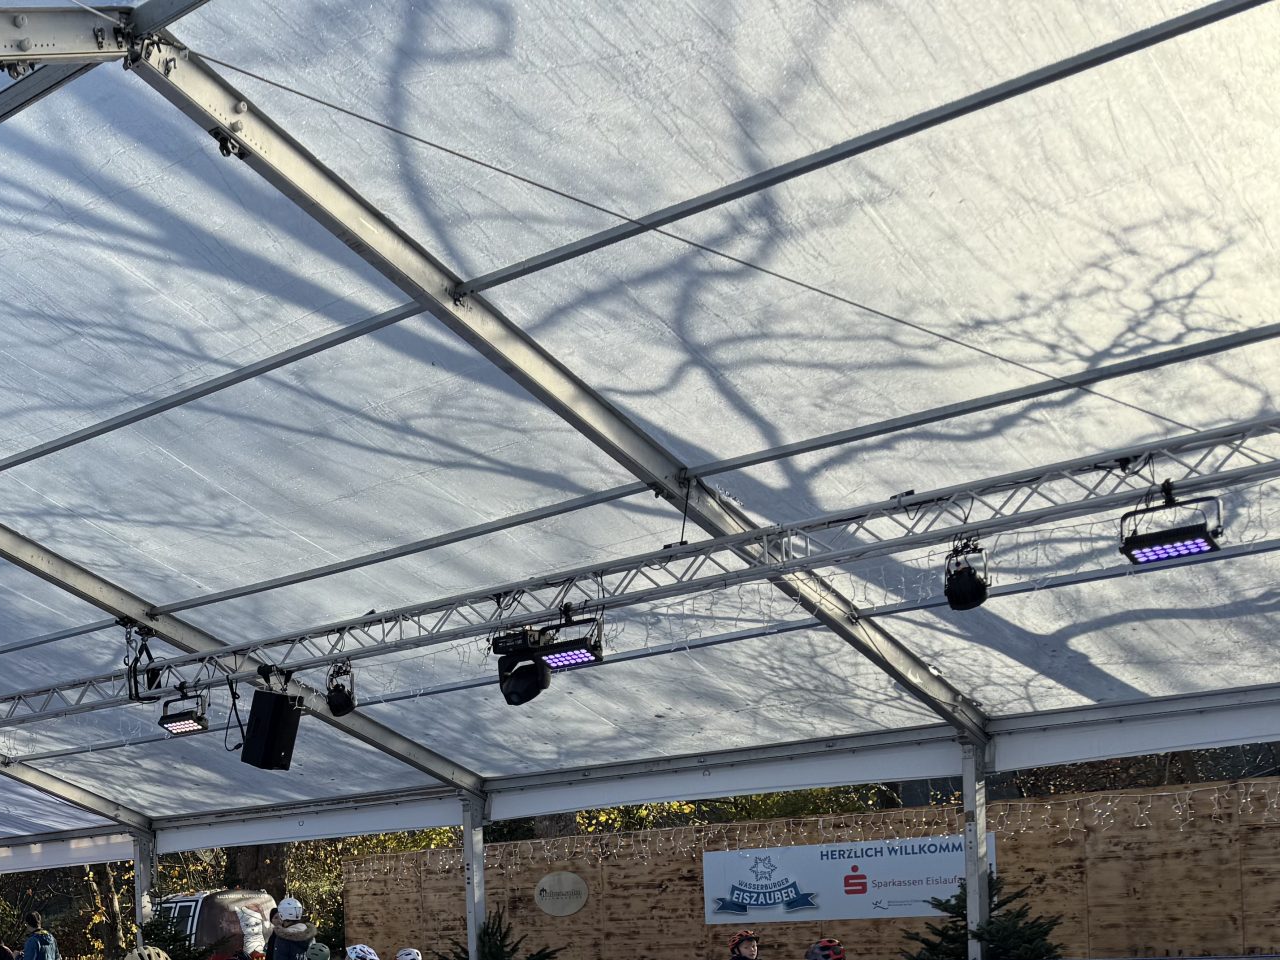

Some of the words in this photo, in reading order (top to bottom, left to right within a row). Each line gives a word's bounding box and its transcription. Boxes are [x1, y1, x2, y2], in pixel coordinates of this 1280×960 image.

[820, 846, 884, 861] HERZLICH
[887, 841, 963, 856] WILLKOMM
[738, 877, 790, 891] WASSERBURGER
[871, 877, 924, 889] Sparkassen
[925, 874, 963, 886] Eislaufa
[732, 888, 797, 905] EISZAUBER
